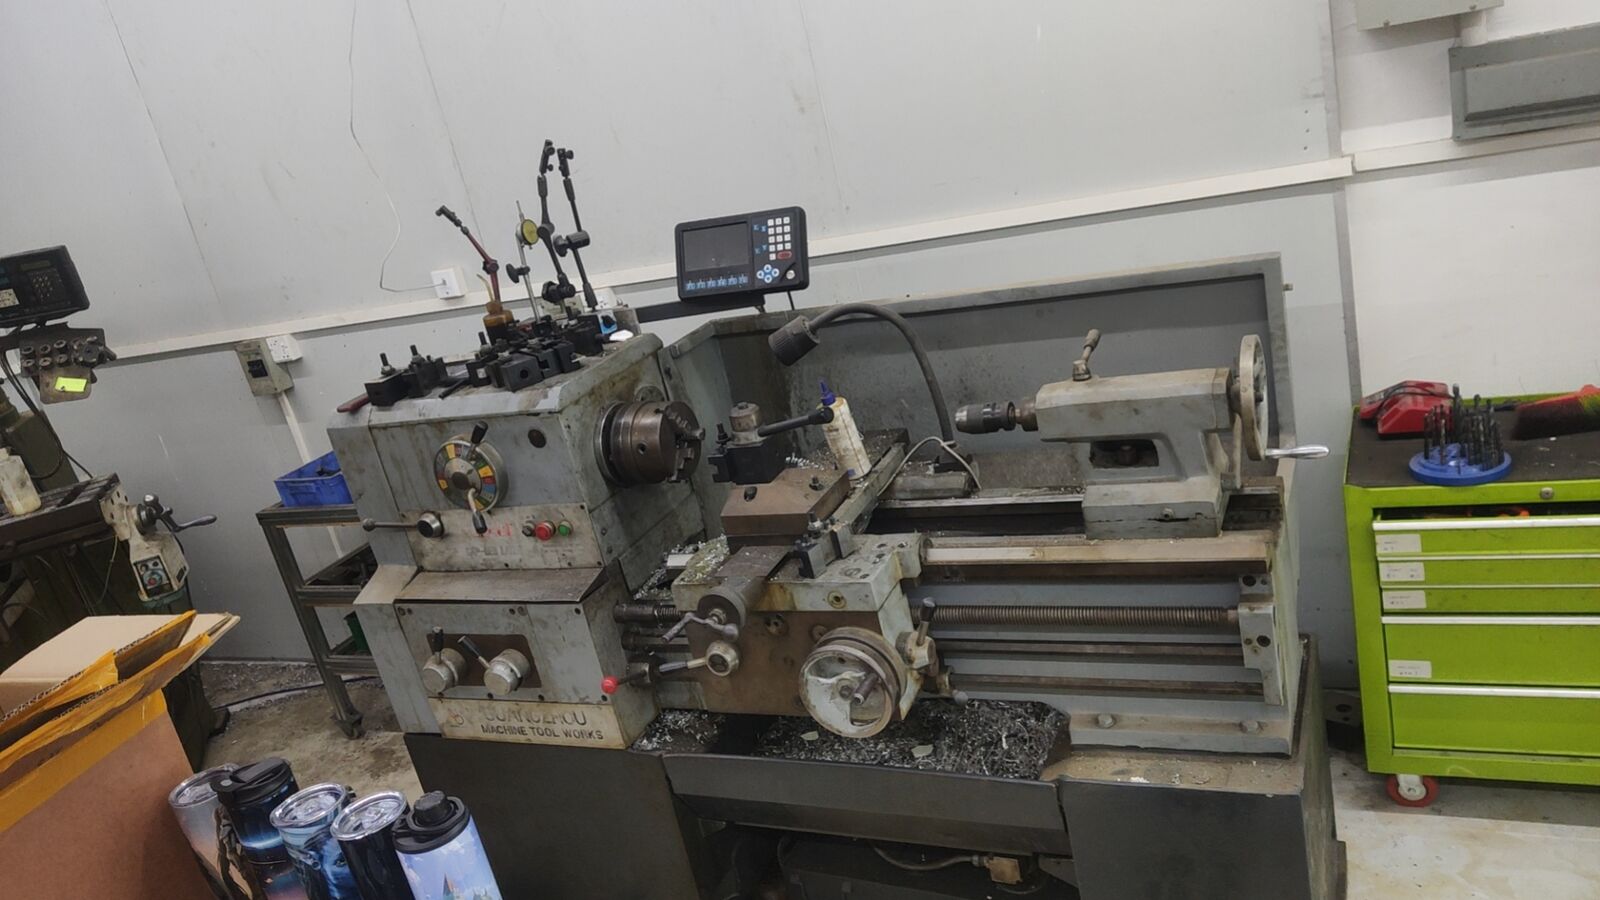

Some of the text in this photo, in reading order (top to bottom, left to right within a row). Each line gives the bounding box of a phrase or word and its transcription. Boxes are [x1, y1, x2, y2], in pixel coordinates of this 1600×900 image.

[480, 724, 604, 740] MACHINE TOOL WORKS
